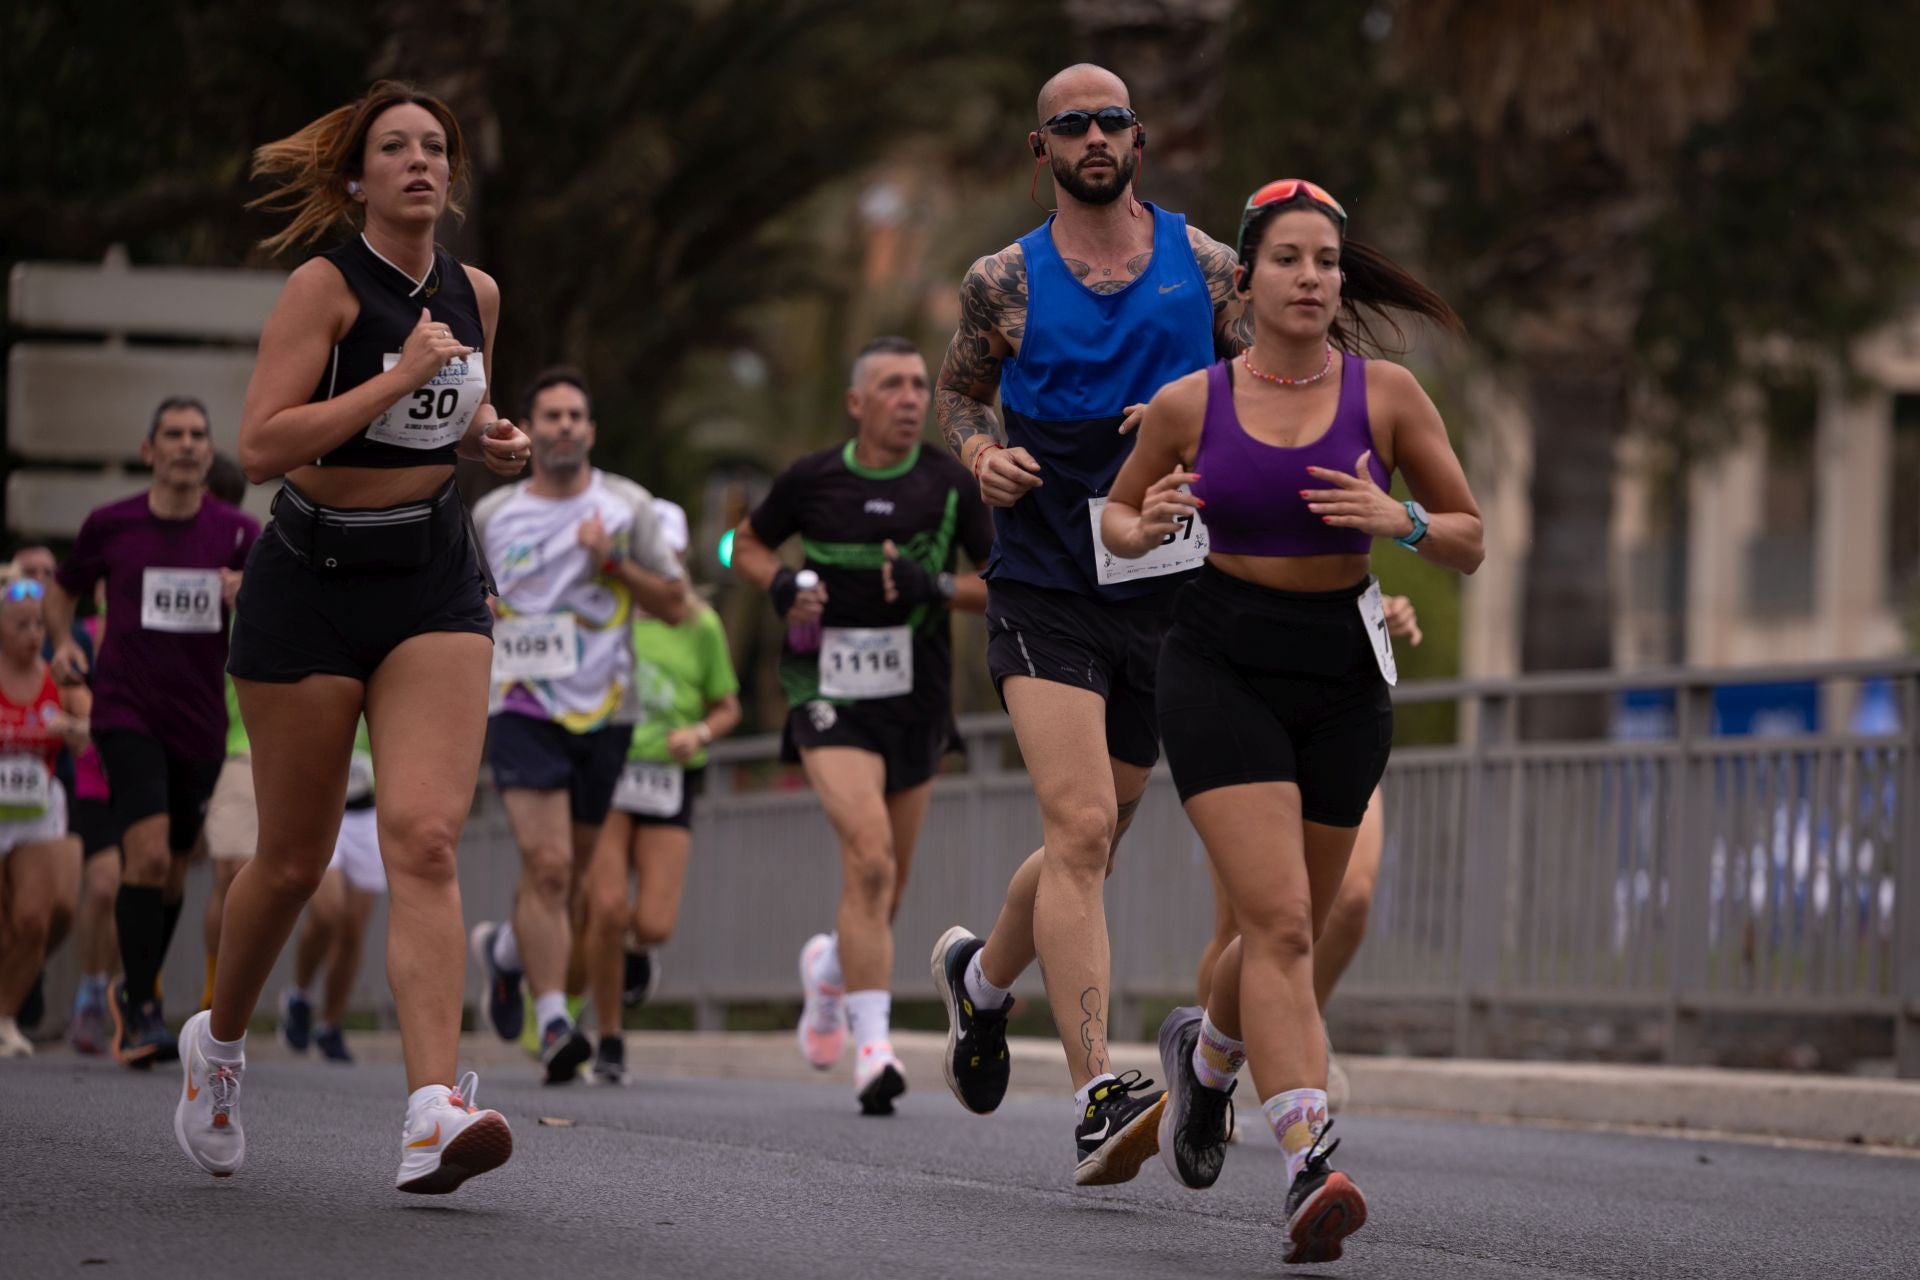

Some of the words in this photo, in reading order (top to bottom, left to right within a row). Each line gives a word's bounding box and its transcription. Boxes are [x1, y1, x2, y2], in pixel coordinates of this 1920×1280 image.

[408, 388, 459, 420] 30
[1158, 512, 1194, 546] 7
[155, 589, 210, 614] 680
[831, 649, 900, 673] 1116
